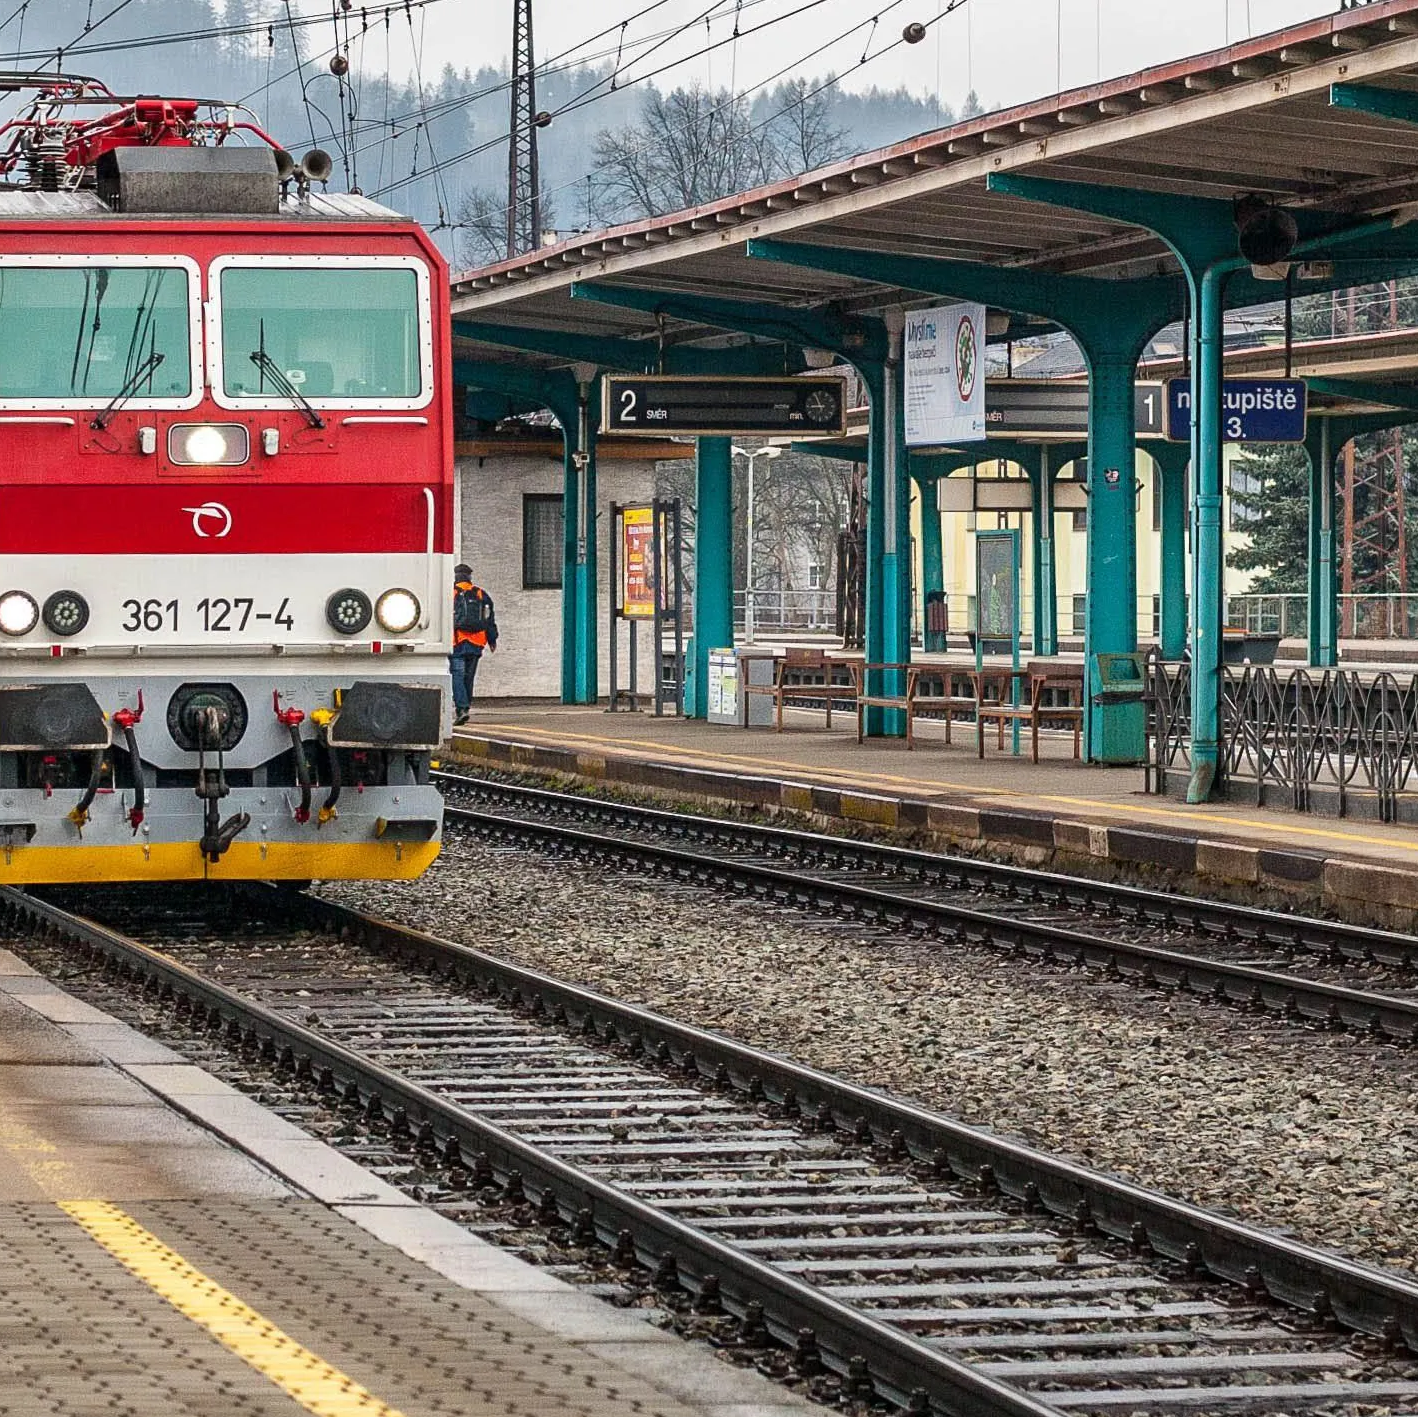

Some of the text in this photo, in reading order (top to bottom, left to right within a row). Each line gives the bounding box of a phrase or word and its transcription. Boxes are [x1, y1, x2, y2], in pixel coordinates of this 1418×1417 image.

[620, 390, 636, 421] 2
[1144, 394, 1153, 425] 1
[1226, 416, 1247, 438] 3.
[121, 597, 294, 632] 361 127-4
